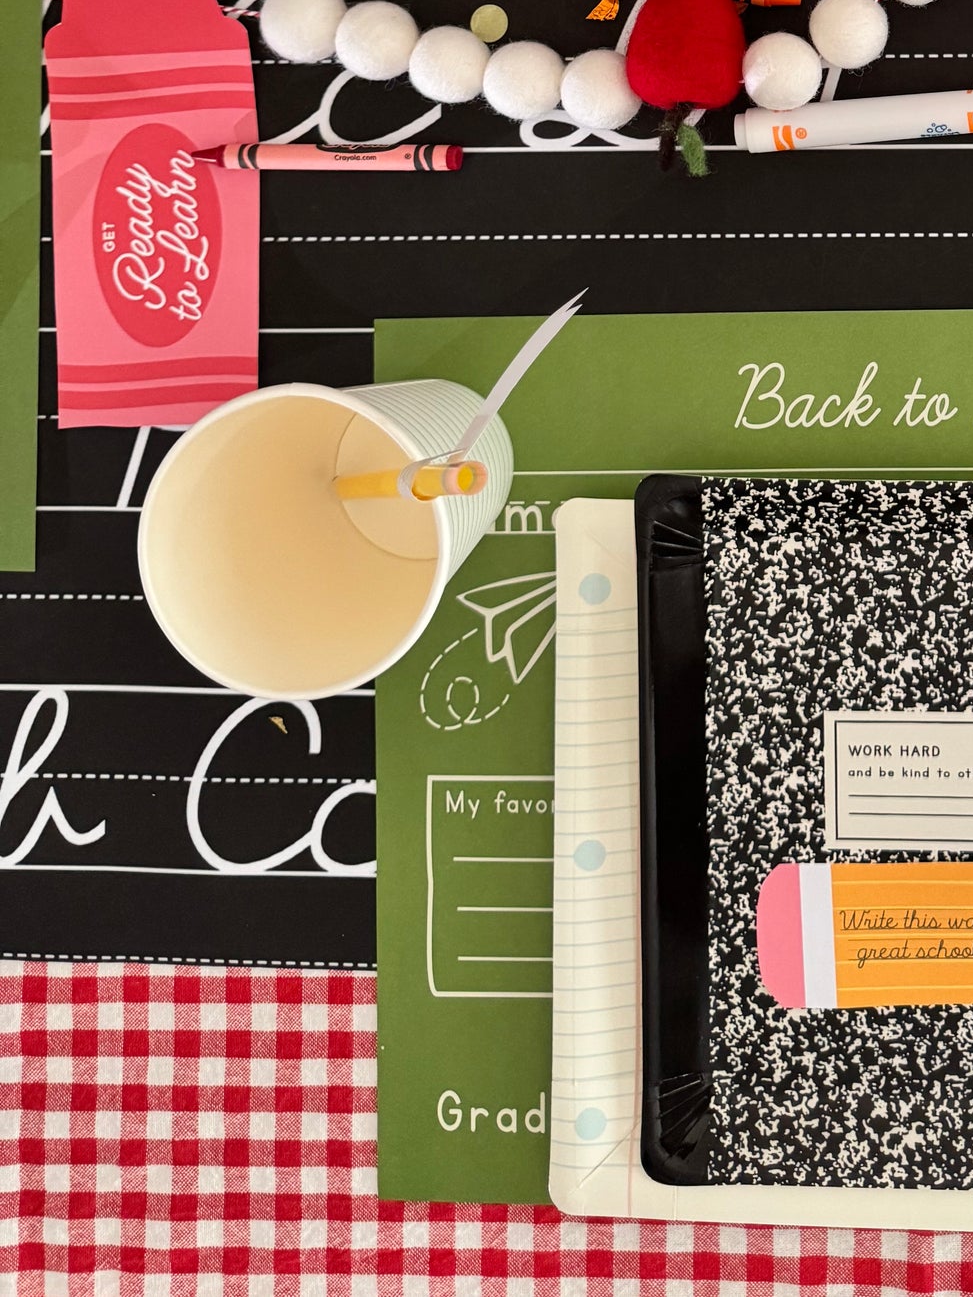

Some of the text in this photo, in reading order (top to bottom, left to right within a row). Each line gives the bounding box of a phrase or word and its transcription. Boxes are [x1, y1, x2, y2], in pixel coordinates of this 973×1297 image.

[334, 154, 377, 162] Crayola.com
[102, 222, 116, 253] GET
[112, 163, 175, 310] Ready
[156, 149, 210, 321] to Learn
[734, 360, 882, 430] Back
[893, 377, 958, 427] to
[848, 744, 941, 758] WORK HARD
[848, 767, 872, 778] and
[879, 767, 894, 778] be
[902, 767, 930, 779] kind
[937, 768, 951, 779] to
[446, 790, 480, 819] My
[839, 909, 898, 931] Write
[903, 909, 942, 931] this
[856, 942, 910, 969] great
[437, 1089, 546, 1134] Grad
